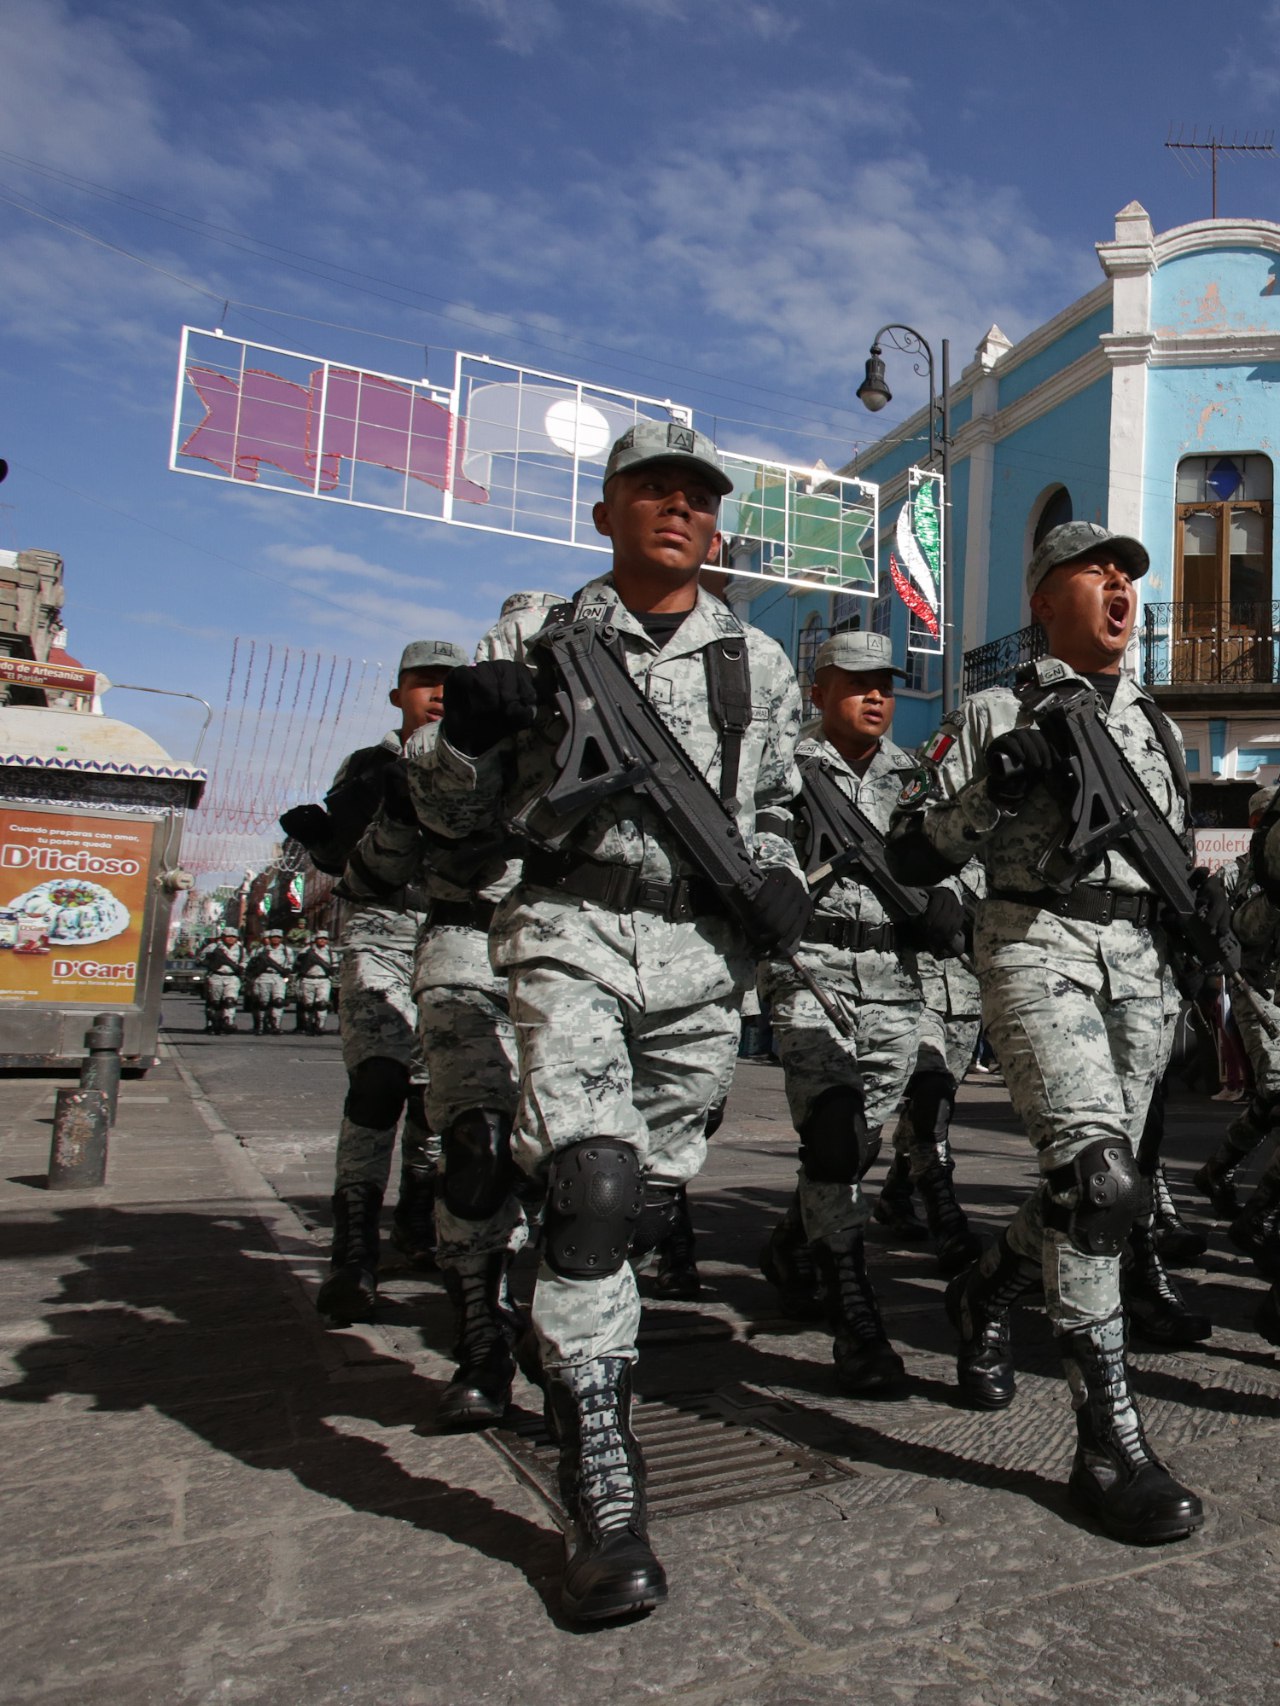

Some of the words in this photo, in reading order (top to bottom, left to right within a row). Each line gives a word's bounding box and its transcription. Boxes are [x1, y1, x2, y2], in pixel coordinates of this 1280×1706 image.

[17, 664, 31, 673] de
[32, 666, 85, 682] Artesanías
[1045, 667, 1061, 679] GN
[9, 824, 48, 834] Cuando
[49, 828, 93, 838] preparas
[94, 832, 113, 840] con
[113, 834, 140, 843] amor,
[49, 838, 81, 846] postre
[82, 840, 112, 849] queda
[1, 844, 140, 876] D'licioso
[52, 959, 137, 980] D'Gari
